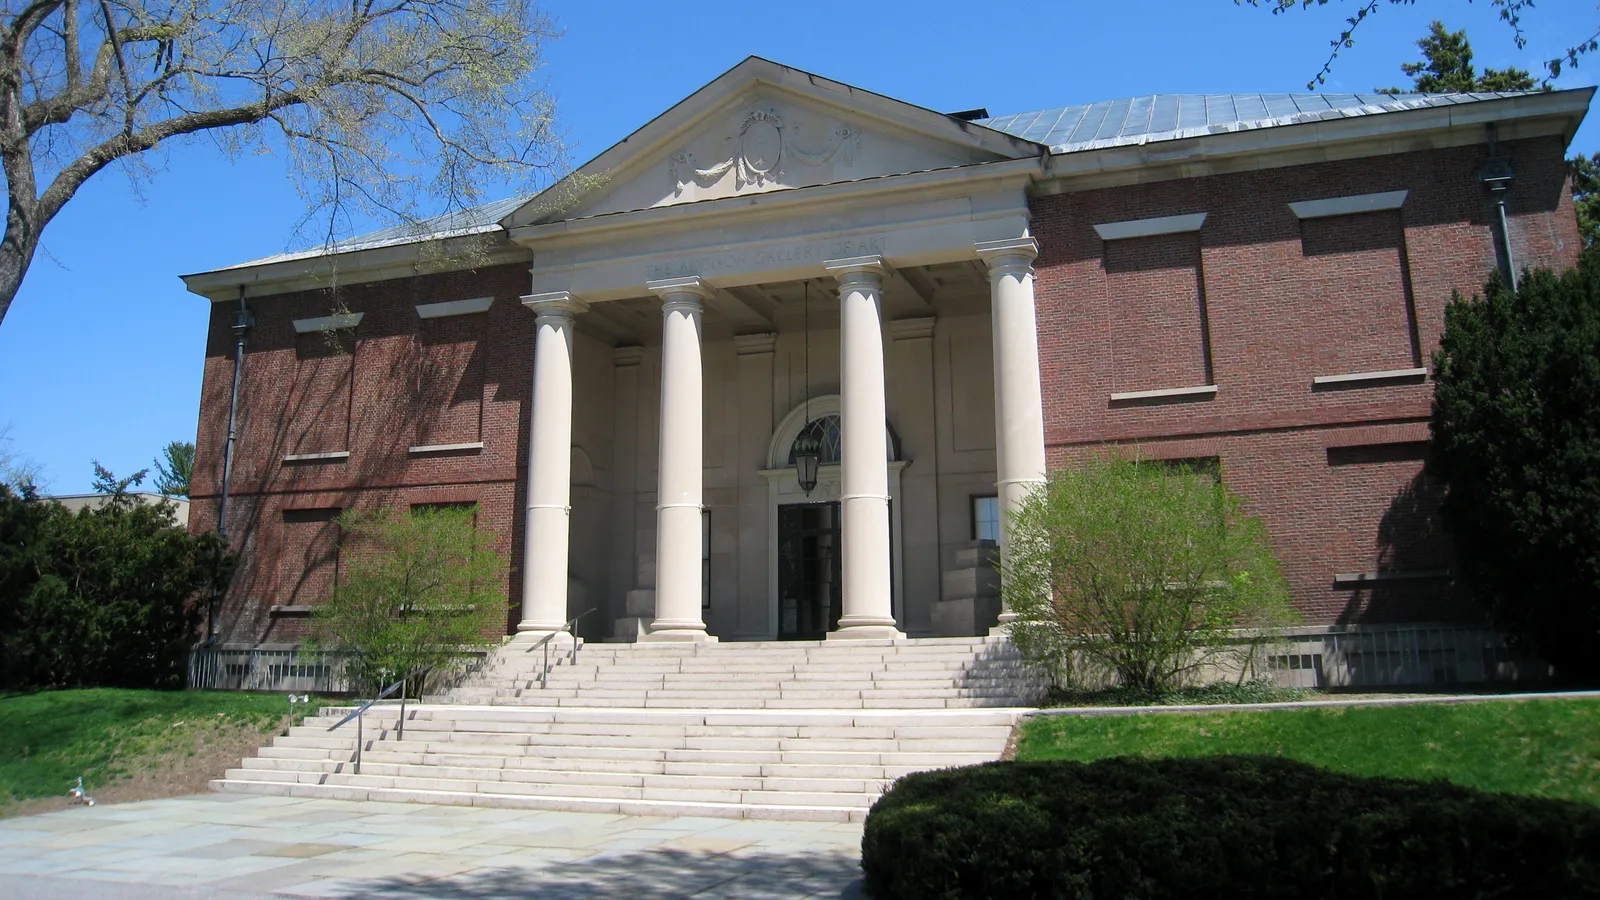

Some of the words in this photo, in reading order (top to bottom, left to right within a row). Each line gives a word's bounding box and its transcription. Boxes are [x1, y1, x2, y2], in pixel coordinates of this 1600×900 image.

[646, 263, 671, 277] THE
[755, 246, 822, 265] GALLERY
[831, 240, 851, 256] OF
[858, 237, 888, 253] ART
